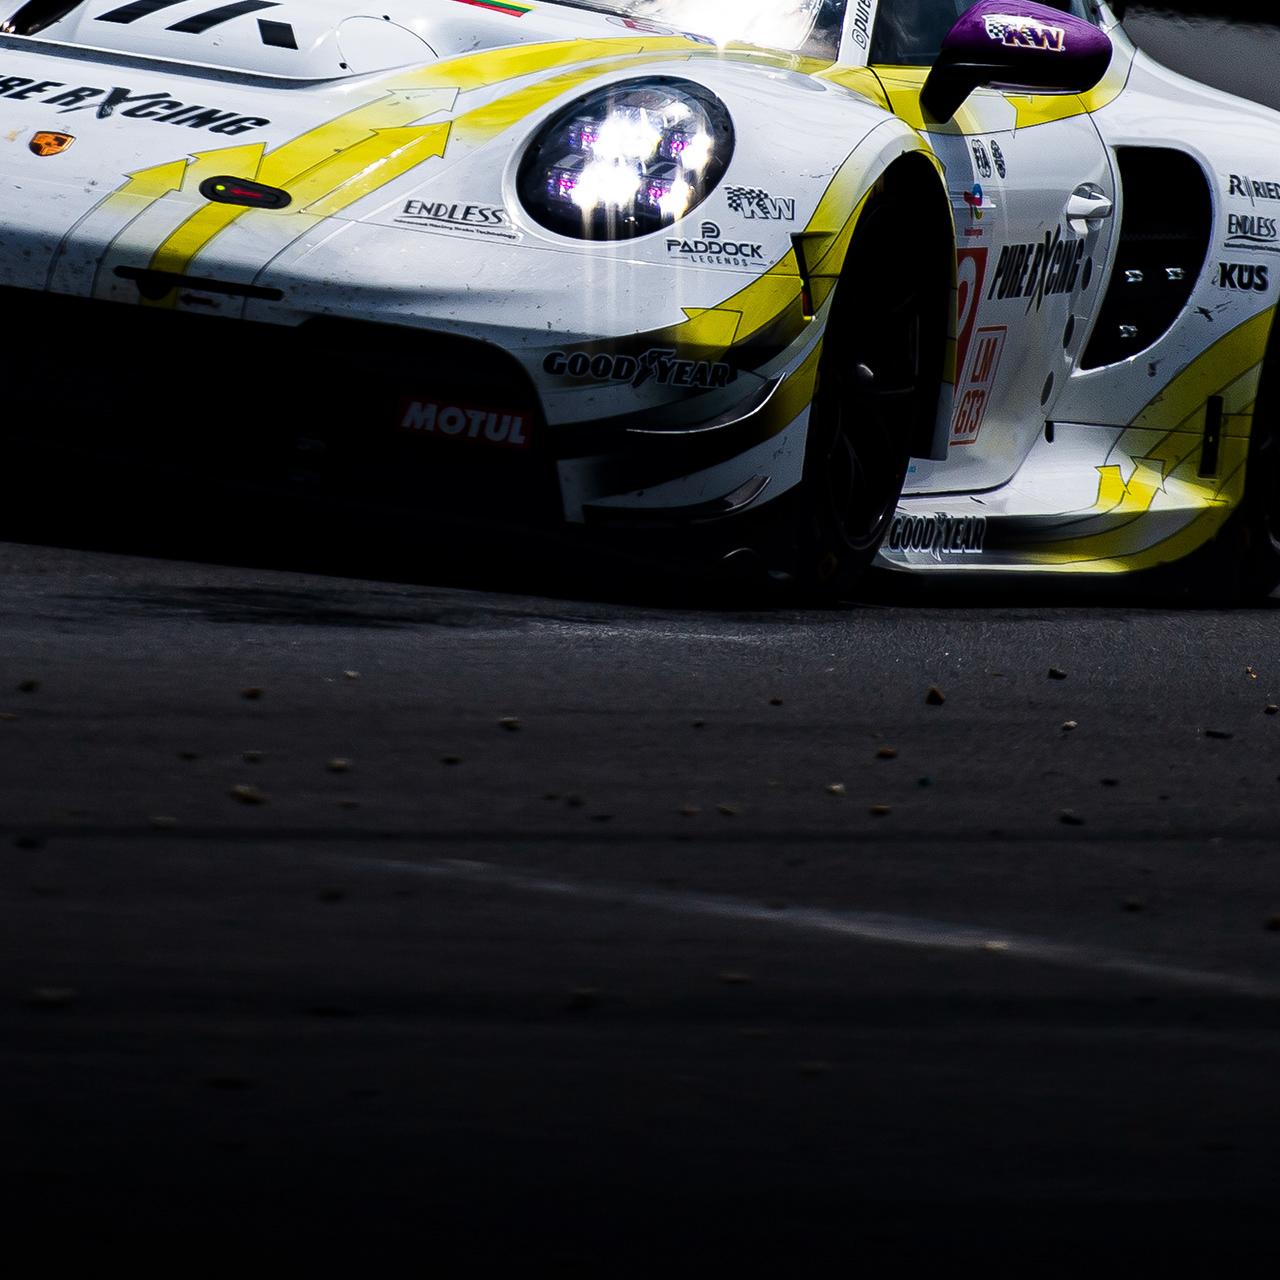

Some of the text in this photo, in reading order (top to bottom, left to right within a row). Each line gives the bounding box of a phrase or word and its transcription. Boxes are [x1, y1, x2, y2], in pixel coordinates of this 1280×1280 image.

[1003, 22, 1063, 51] KW
[42, 86, 271, 136] RXCING
[403, 199, 505, 224] ENDLESS
[740, 197, 796, 221] KW
[1227, 213, 1277, 238] ENDLESS
[666, 239, 763, 259] PADDOCK
[690, 255, 749, 267] LEGENDS
[987, 242, 1035, 301] PURE
[542, 348, 731, 389] GOODYEAR
[970, 337, 998, 384] LM
[400, 401, 527, 445] MOTUL
[954, 389, 986, 435] GT3
[888, 515, 987, 556] GOODYEAR
